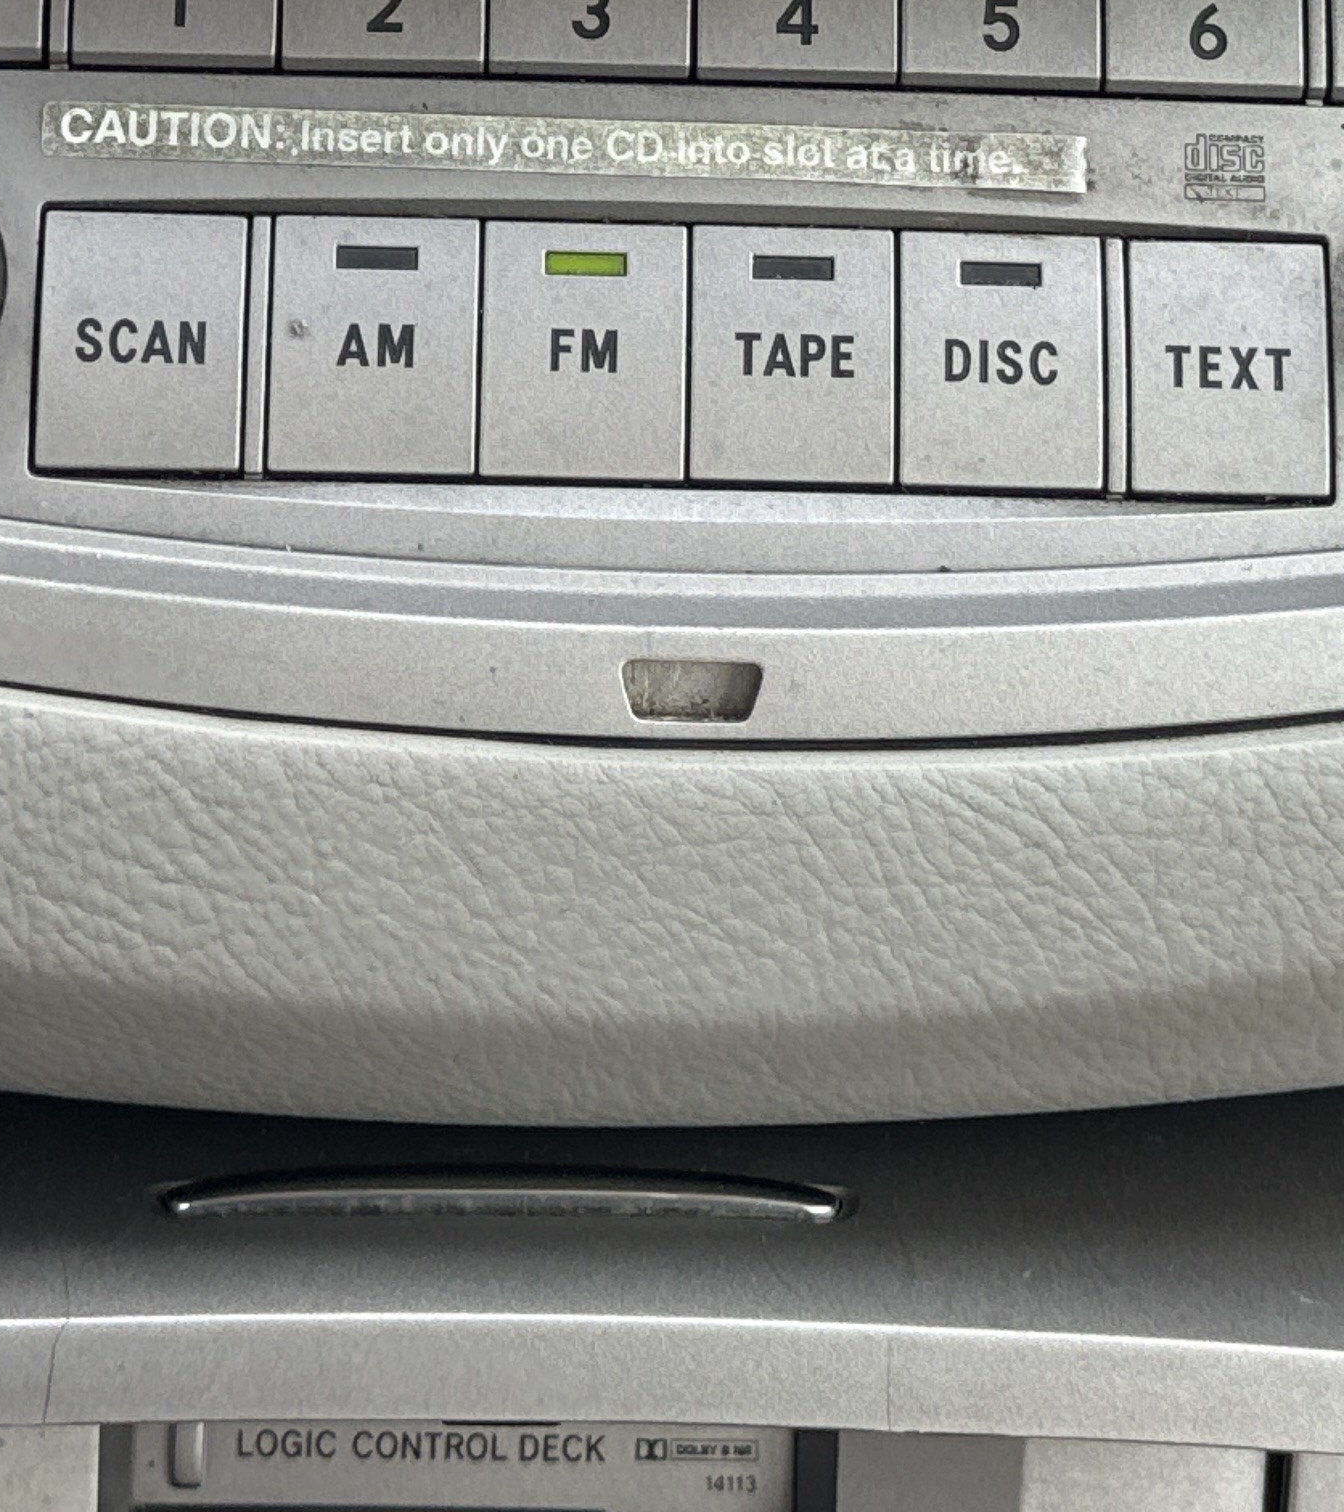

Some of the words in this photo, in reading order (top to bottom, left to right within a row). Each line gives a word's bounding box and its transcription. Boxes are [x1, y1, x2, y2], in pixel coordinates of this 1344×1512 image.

[1189, 2, 1228, 61] 6
[300, 118, 413, 156] Insert
[424, 122, 509, 169] only
[520, 134, 592, 167] one
[606, 131, 660, 164] CD
[677, 133, 749, 167] into
[762, 135, 833, 170] slot
[889, 148, 915, 174] a
[1184, 133, 1265, 173] disc
[75, 317, 207, 365] SCAN
[336, 323, 415, 369] AM
[550, 328, 618, 374] FM
[734, 332, 855, 379] TAPE
[944, 338, 1058, 386] DISC
[1164, 344, 1292, 392] TEXT
[236, 1428, 336, 1459] LOGIC
[351, 1430, 508, 1462] CONTROL
[518, 1433, 605, 1463] DECK
